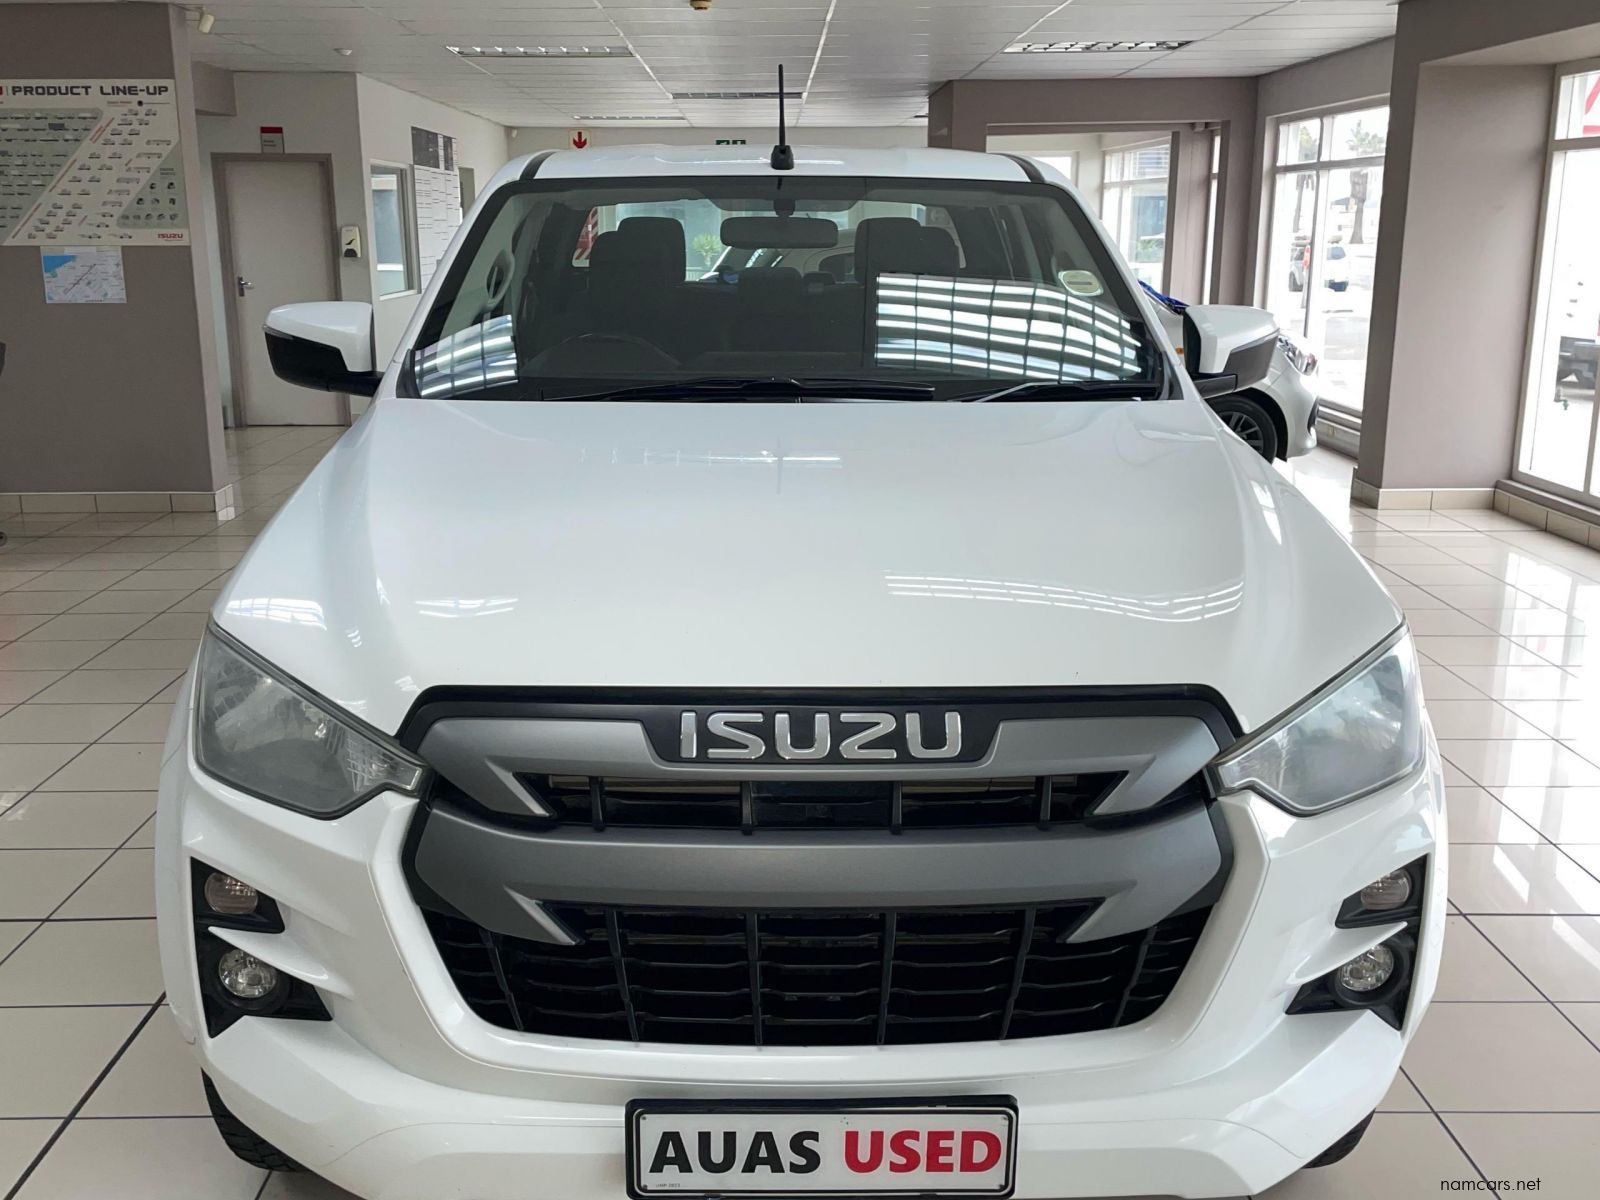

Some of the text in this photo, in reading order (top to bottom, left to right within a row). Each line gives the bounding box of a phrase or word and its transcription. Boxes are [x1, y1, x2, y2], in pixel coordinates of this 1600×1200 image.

[12, 86, 92, 96] PRODUCT
[100, 86, 169, 95] LINE-UP
[680, 711, 962, 759] ISUZU
[649, 1130, 1002, 1174] AUAS USED
